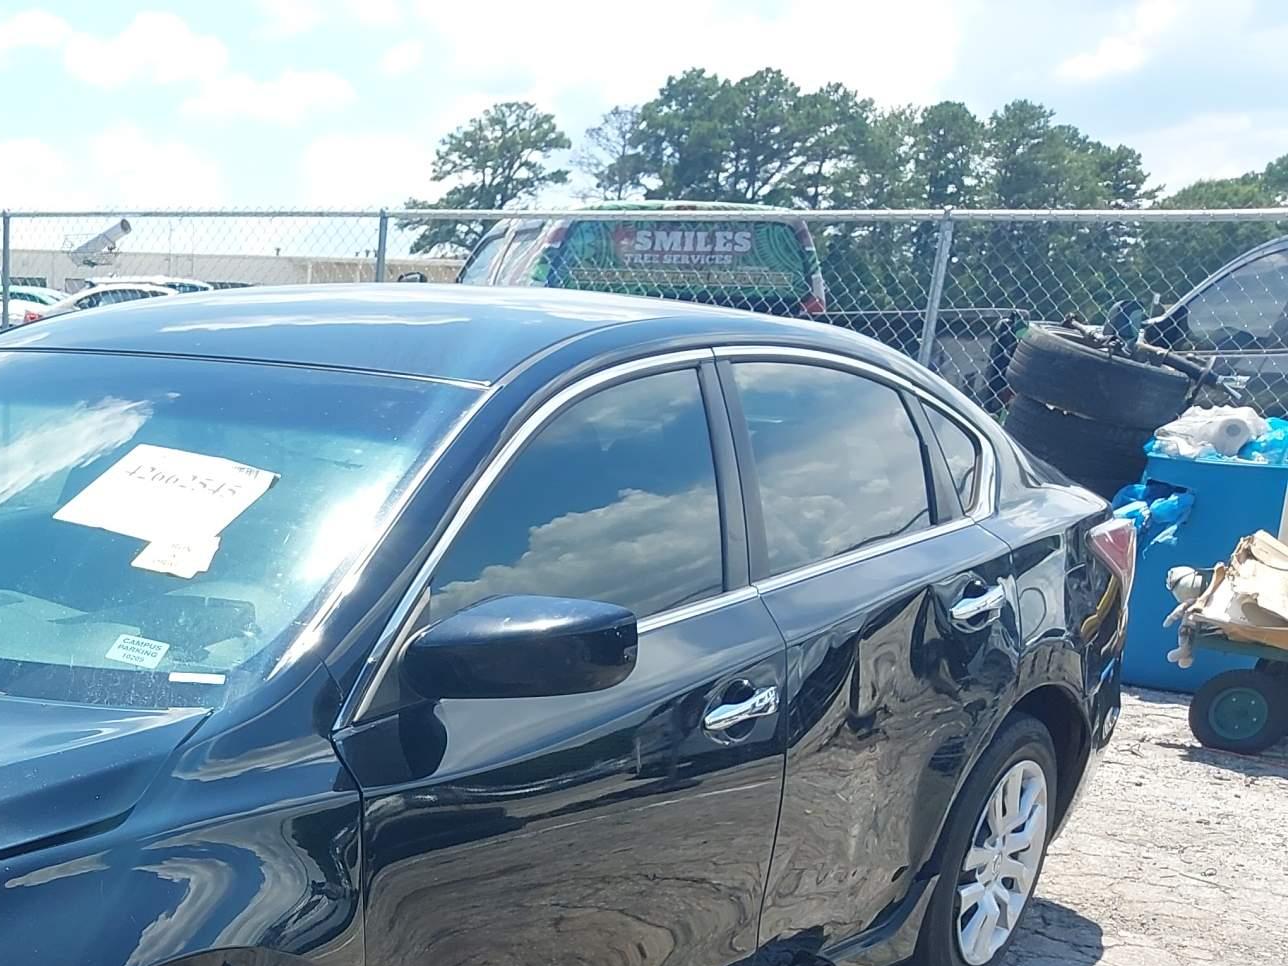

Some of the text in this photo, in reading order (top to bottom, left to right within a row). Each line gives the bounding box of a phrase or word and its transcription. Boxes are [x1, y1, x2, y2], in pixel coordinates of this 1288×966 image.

[634, 230, 753, 251] SMILES
[624, 253, 660, 264] TREE
[118, 644, 158, 657] PARKING
[123, 638, 162, 651] CAMPUS
